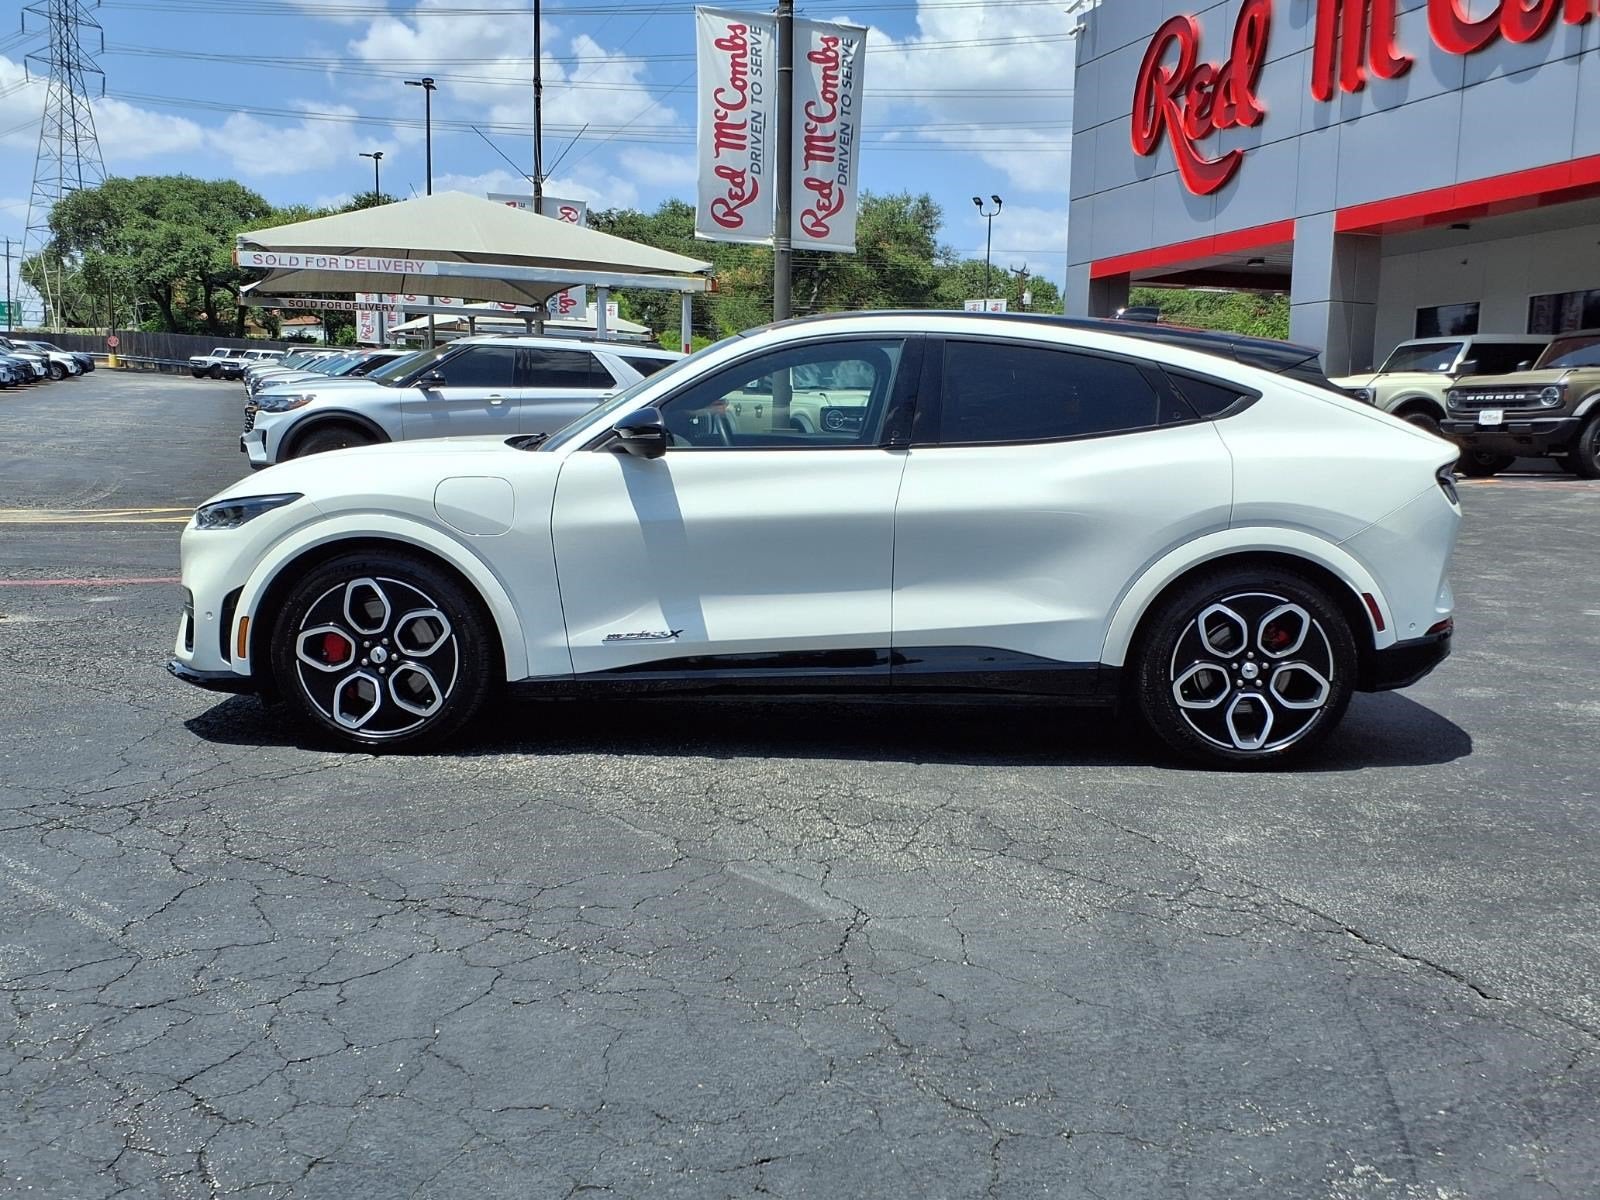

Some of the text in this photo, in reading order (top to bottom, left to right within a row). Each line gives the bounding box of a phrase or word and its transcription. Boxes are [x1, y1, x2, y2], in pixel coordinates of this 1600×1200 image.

[710, 24, 758, 228] Red McCombs
[750, 25, 763, 175] DRIVEN TO SERVE
[800, 36, 844, 238] Red McCombs
[838, 38, 853, 186] DRIVEN TO SERVE
[1131, 0, 1271, 195] Red
[252, 253, 425, 273] SOLD FOR DELIVERY
[288, 299, 396, 312] SOLD FOR DELIVERY
